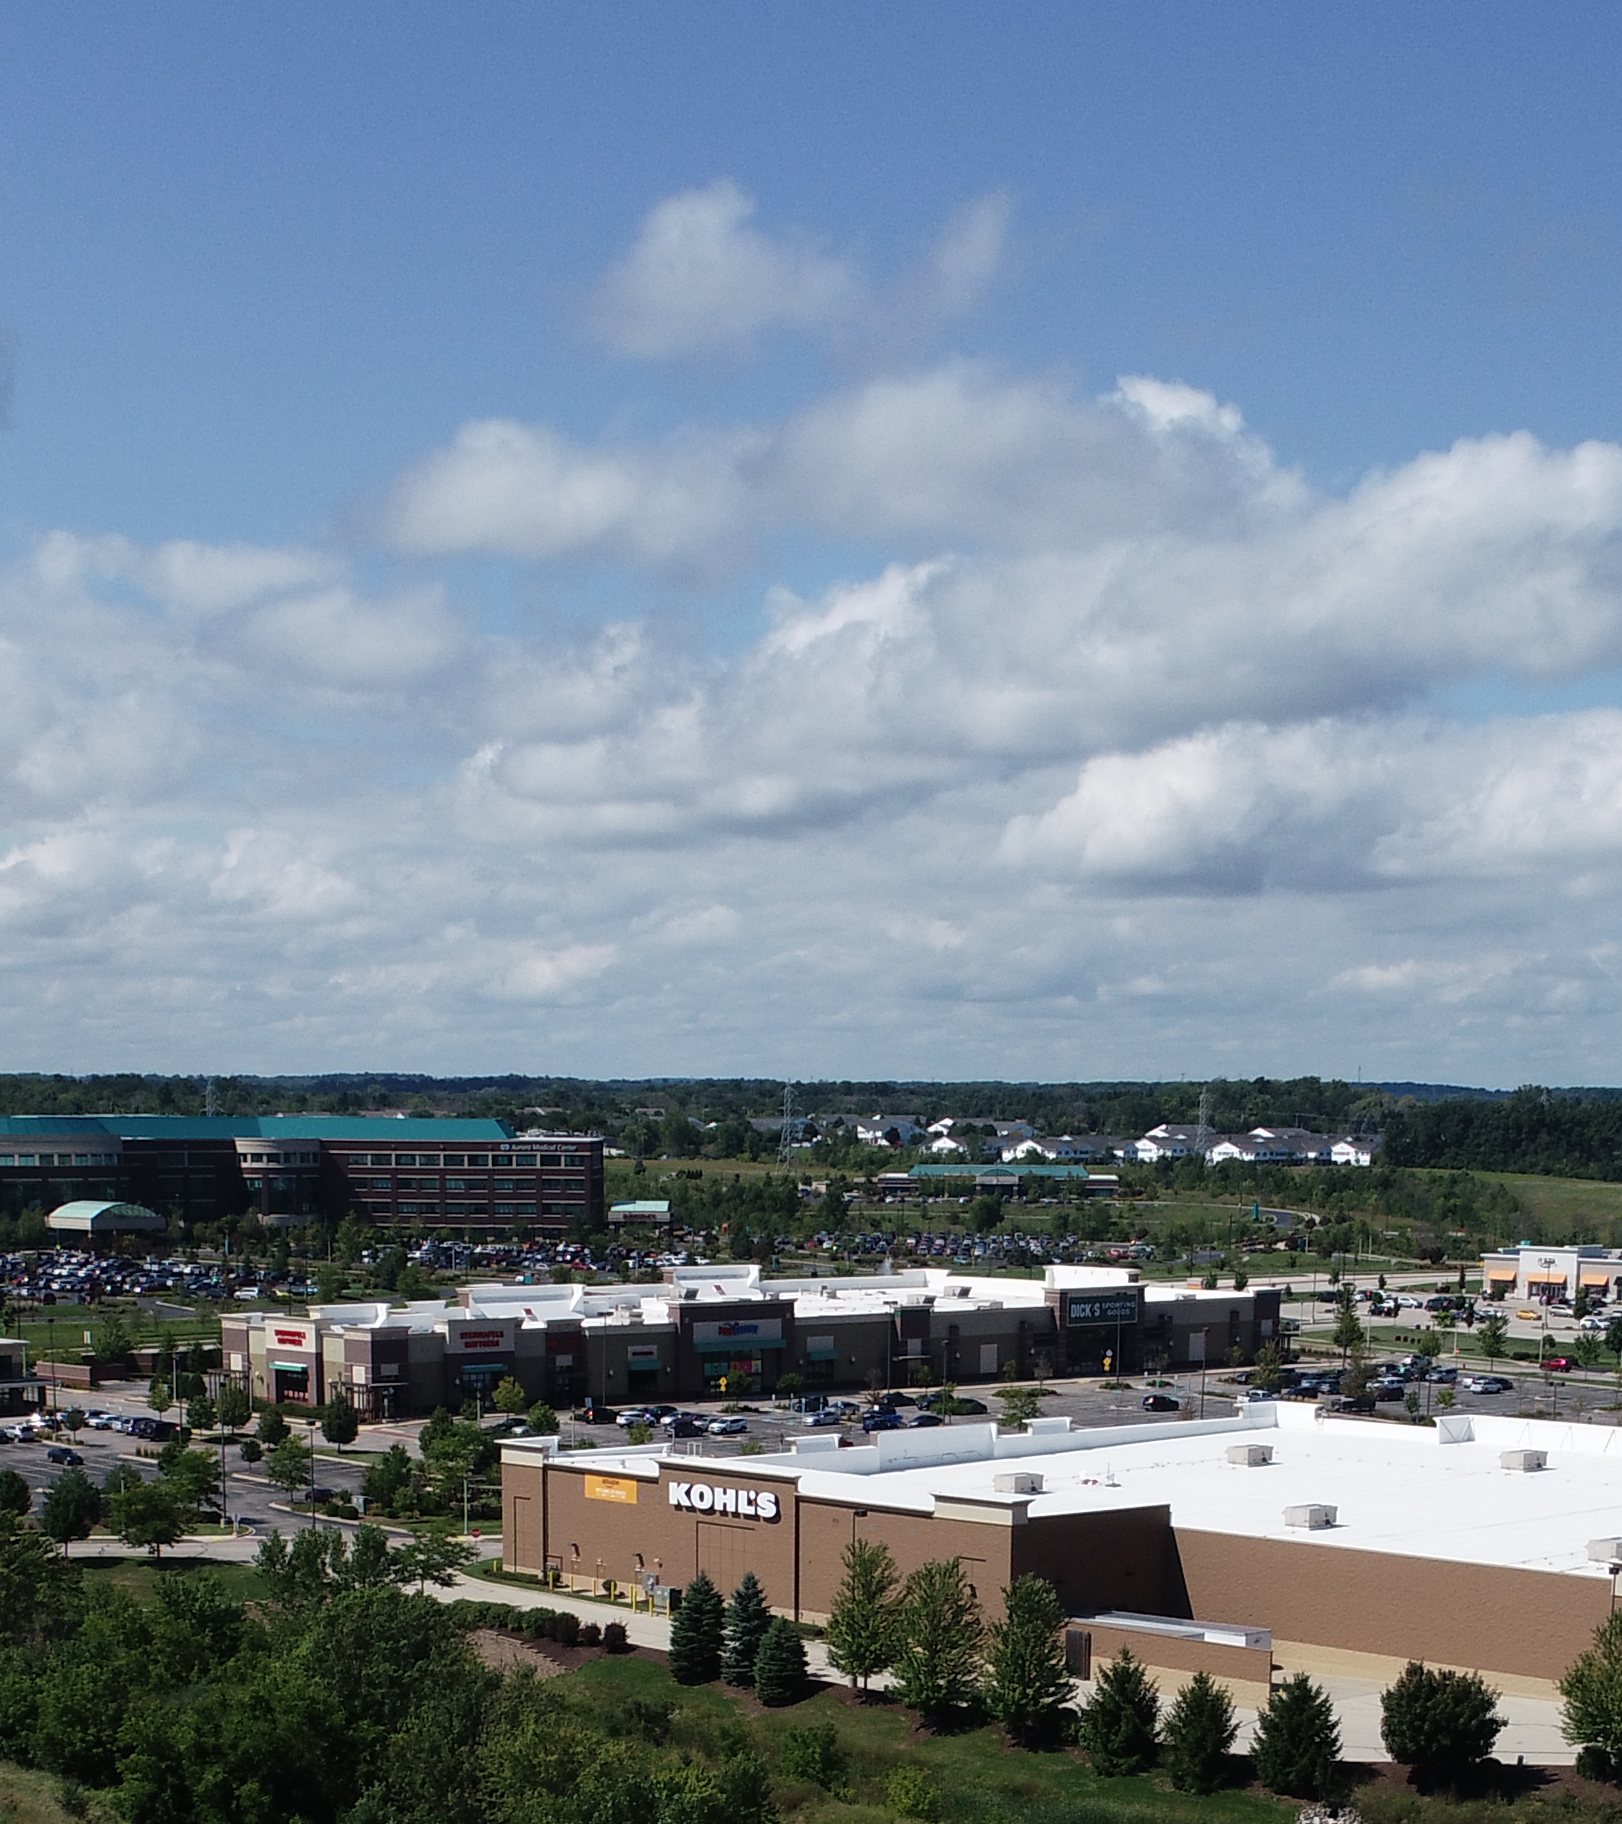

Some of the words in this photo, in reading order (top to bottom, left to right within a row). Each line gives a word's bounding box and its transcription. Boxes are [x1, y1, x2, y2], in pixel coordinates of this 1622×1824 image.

[511, 1143, 531, 1151] Aurora
[532, 1143, 556, 1151] Medical
[557, 1143, 577, 1152] Center
[1070, 1302, 1101, 1318] DICK'S
[1101, 1301, 1136, 1309] SPORTING
[1106, 1308, 1131, 1316] GOODS
[668, 1481, 778, 1518] KOHL'S
